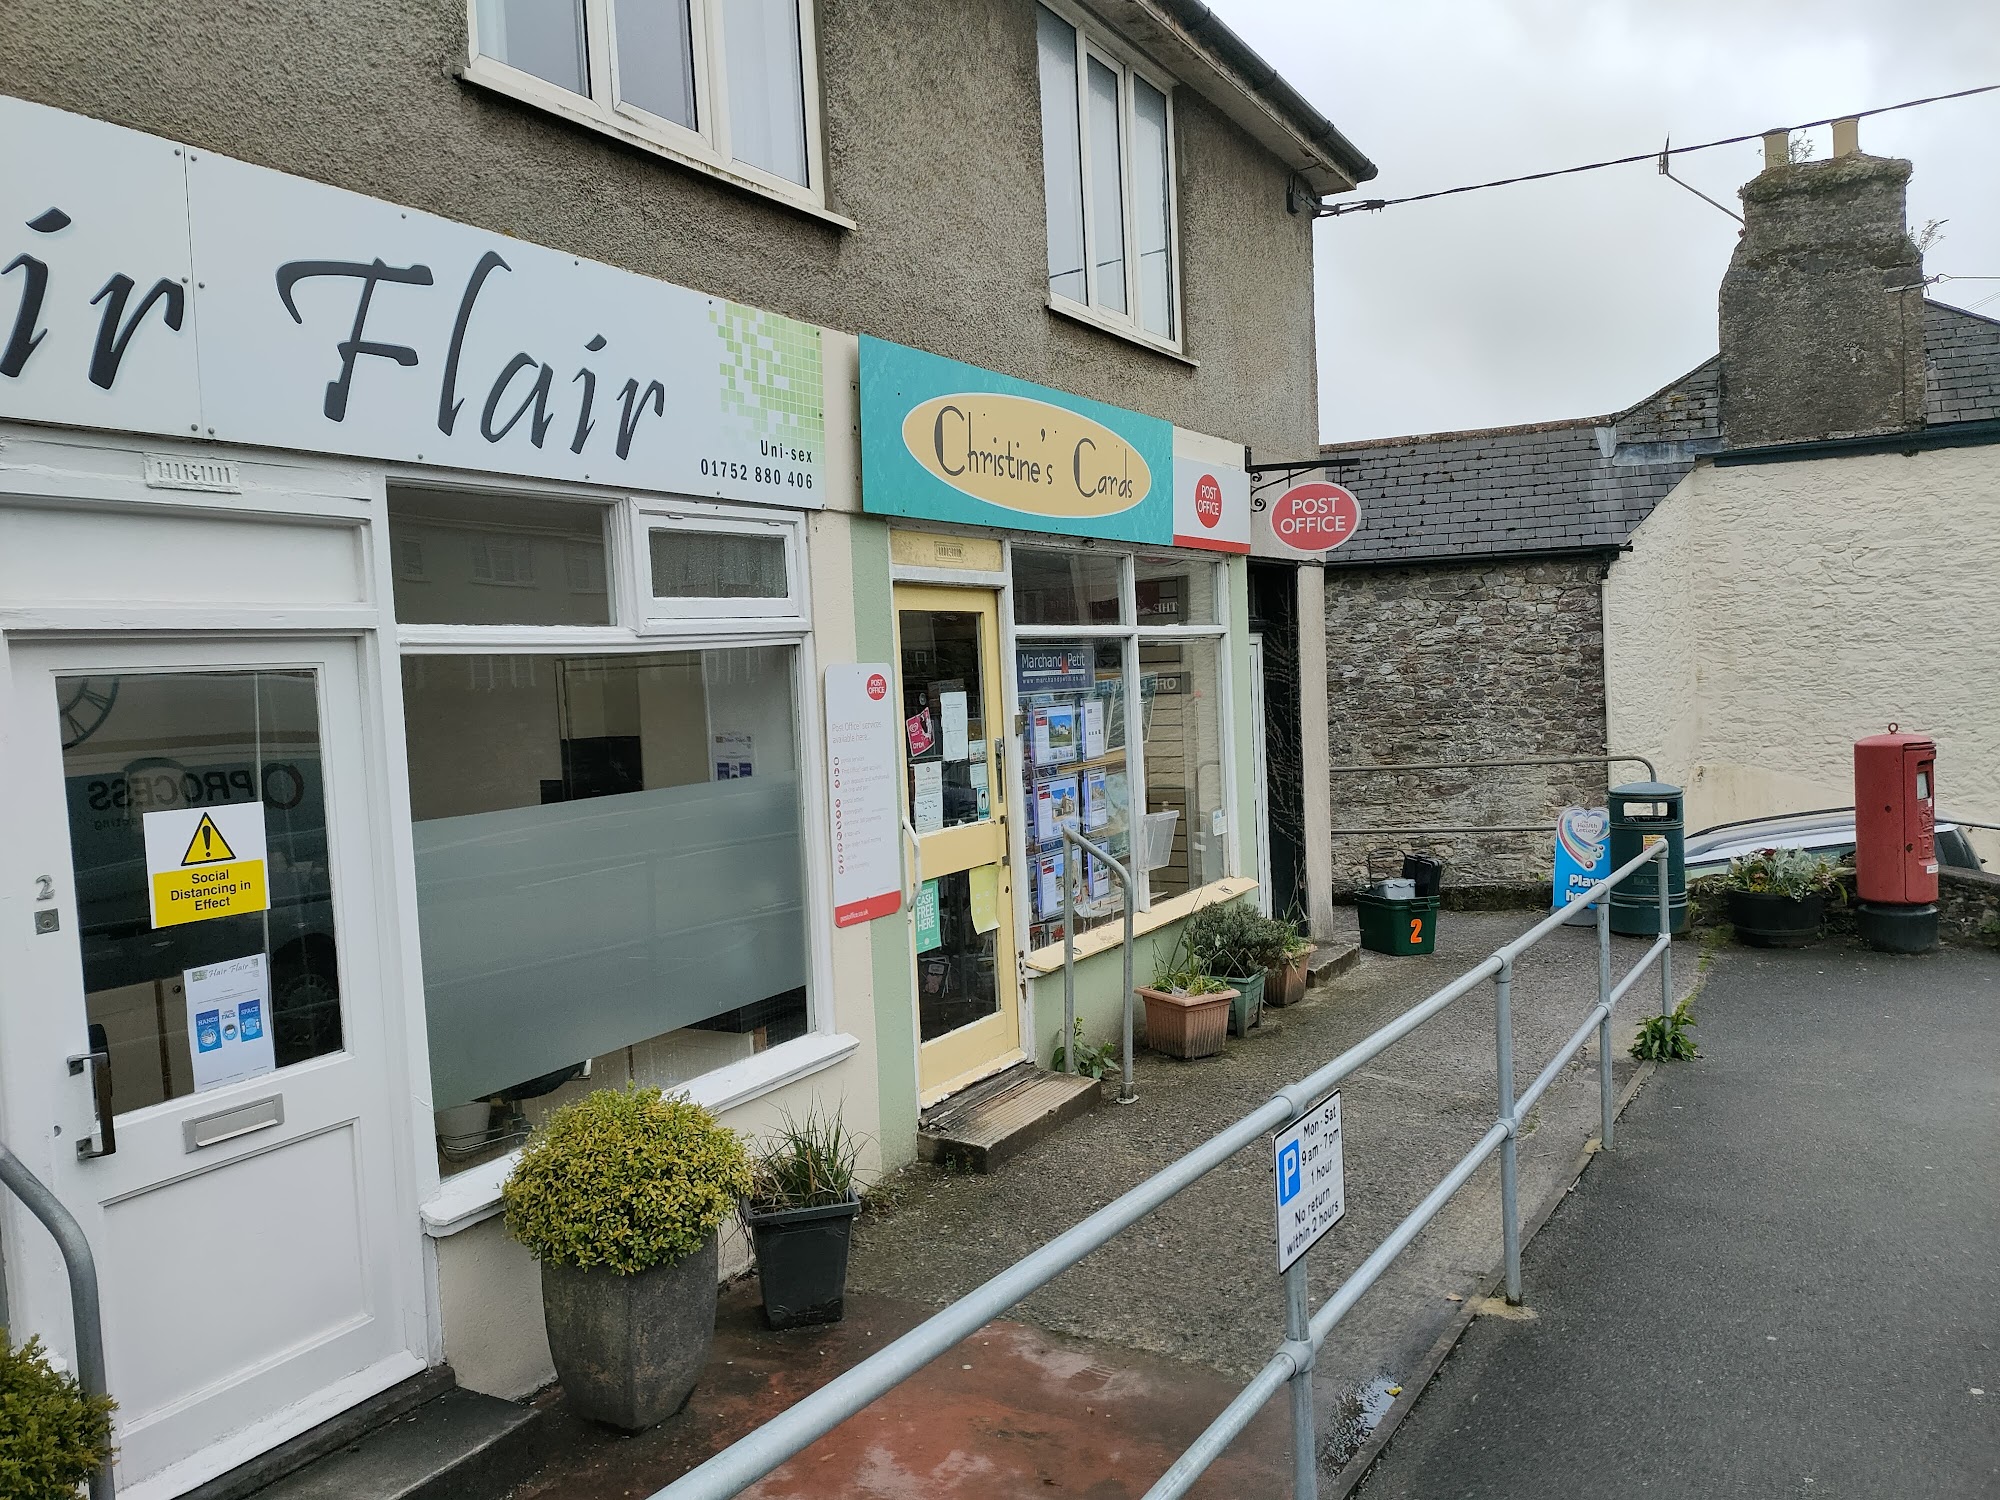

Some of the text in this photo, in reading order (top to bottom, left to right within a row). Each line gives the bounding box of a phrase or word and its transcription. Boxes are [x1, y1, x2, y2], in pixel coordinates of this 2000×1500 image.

[275, 249, 666, 462] Flair
[760, 439, 813, 464] Uni-sex
[933, 405, 1134, 500] Christine's Cards
[700, 458, 813, 489] 01752 880 406
[1201, 484, 1218, 500] POST
[1197, 499, 1220, 516] OFFICE
[1291, 497, 1340, 516] POST
[1280, 515, 1346, 535] OFFICE
[1021, 652, 1086, 669] Marchand Petit
[868, 686, 885, 695] OFFICE
[870, 678, 884, 687] POST
[191, 869, 229, 884] Social
[35, 874, 55, 901] 2
[170, 880, 251, 901] Distancing in
[195, 896, 231, 911] Effect
[916, 892, 934, 907] CASH
[916, 903, 935, 921] FREE
[917, 915, 935, 932] HERE
[1409, 918, 1423, 944] 2
[208, 963, 249, 978] Hair Flair
[1303, 1121, 1320, 1142] Mon
[1324, 1104, 1337, 1125] Sat
[1283, 1148, 1297, 1198] P
[1316, 1159, 1332, 1182] hour
[1295, 1187, 1331, 1228] No return
[1286, 1200, 1339, 1257] within 2 hours
